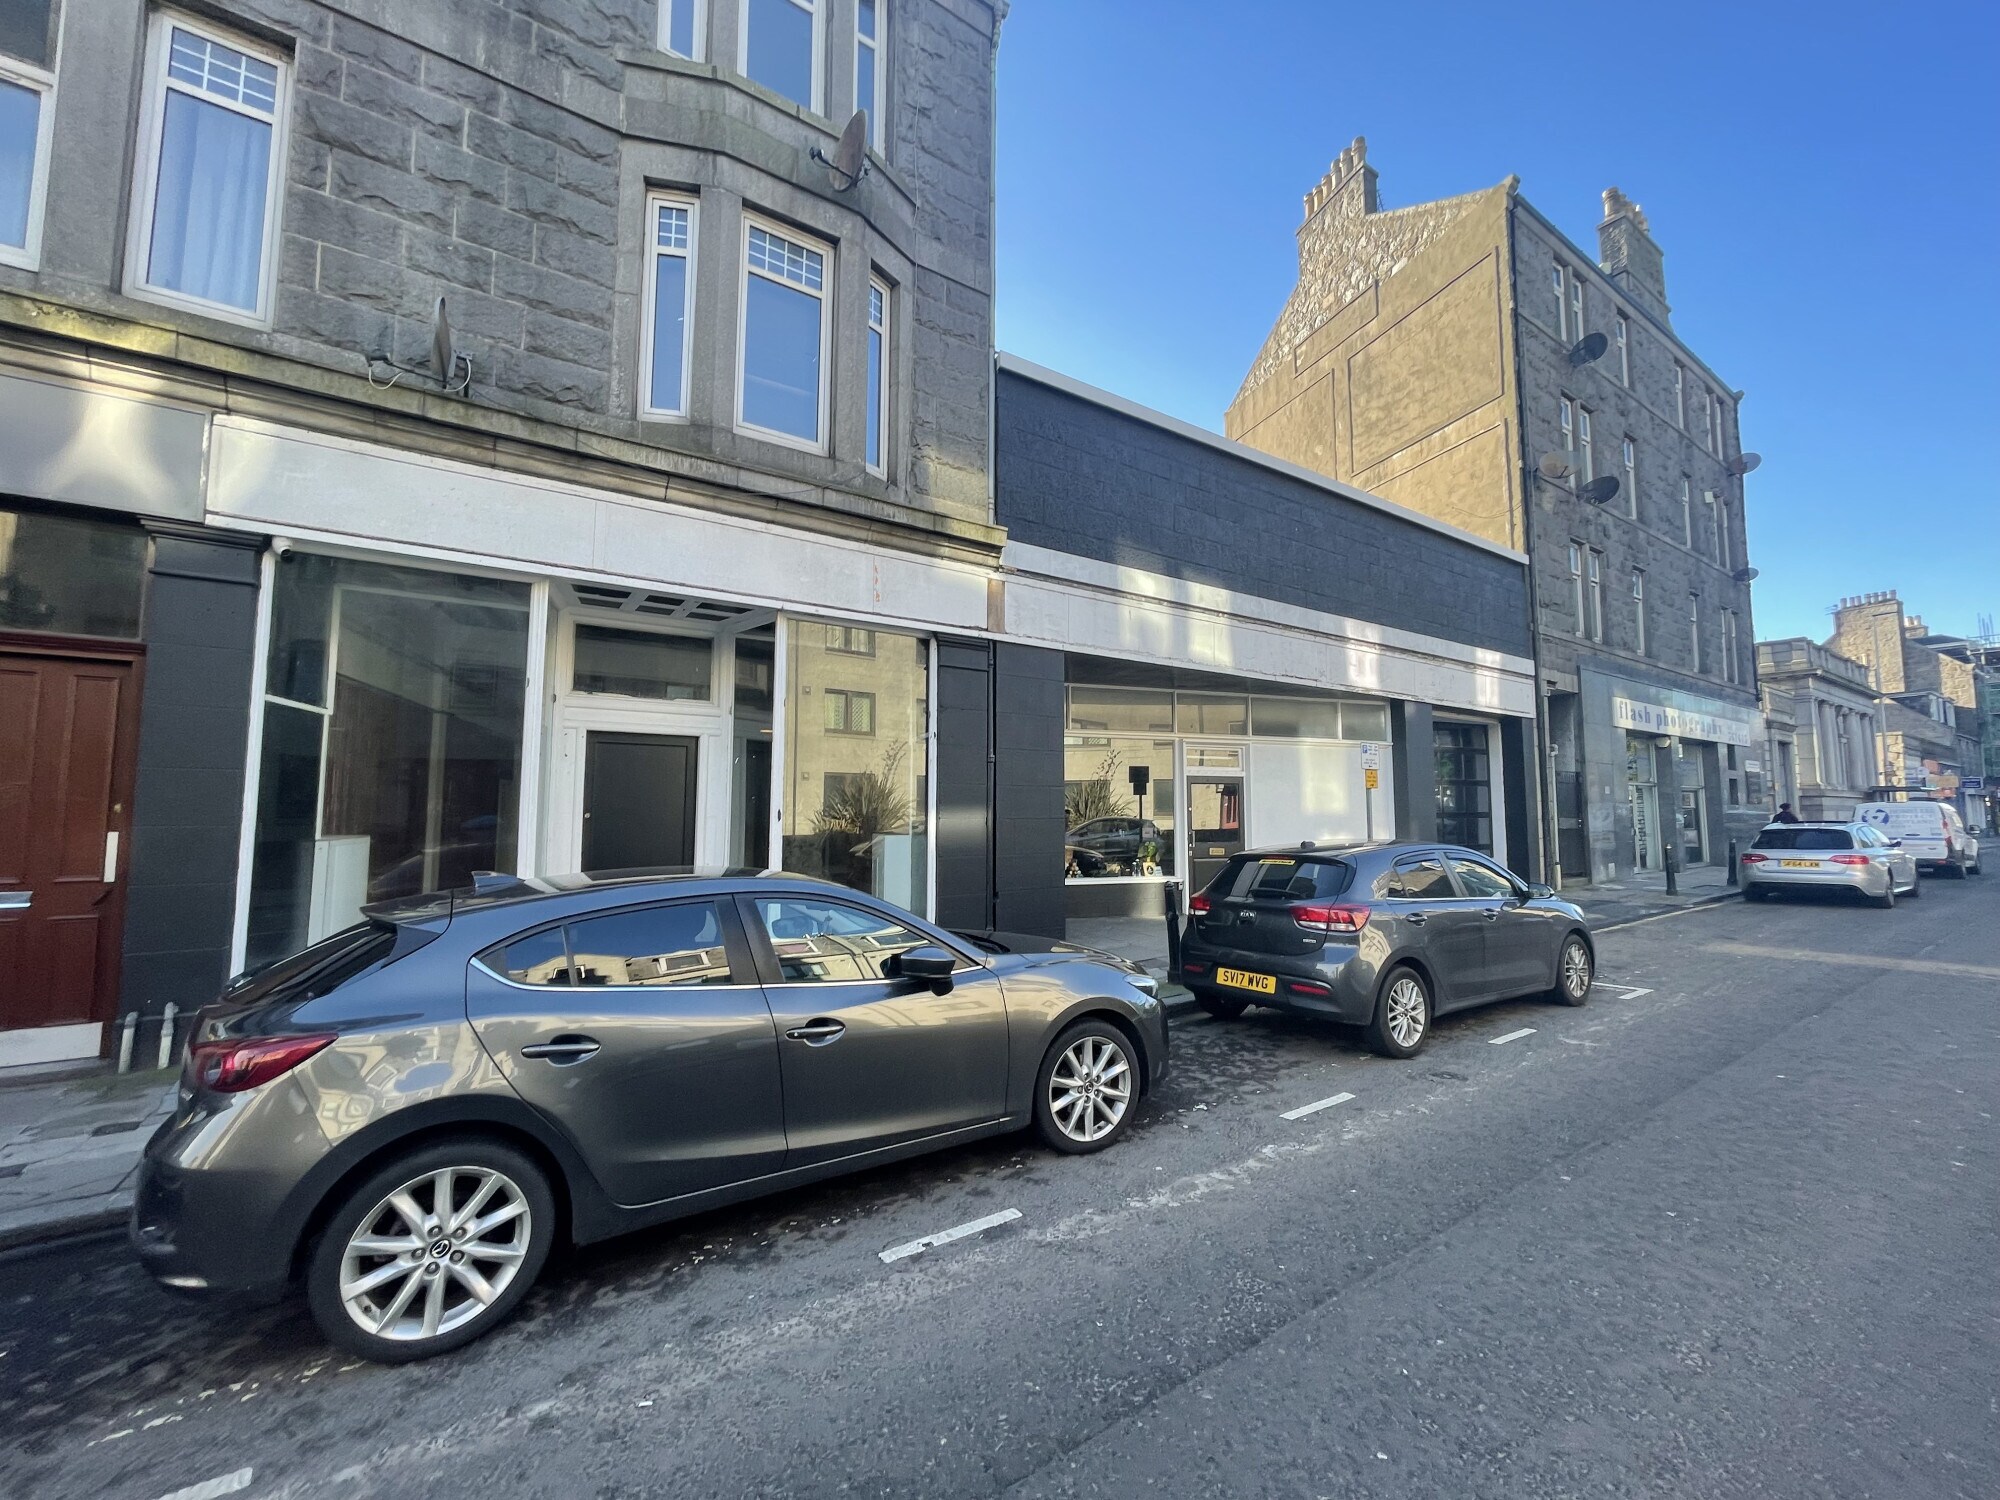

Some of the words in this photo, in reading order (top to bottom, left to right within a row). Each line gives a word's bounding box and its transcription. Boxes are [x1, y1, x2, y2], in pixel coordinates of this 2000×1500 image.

[1619, 700, 1651, 724] flash
[1223, 970, 1246, 985] SV17
[1247, 974, 1269, 989] WVG
